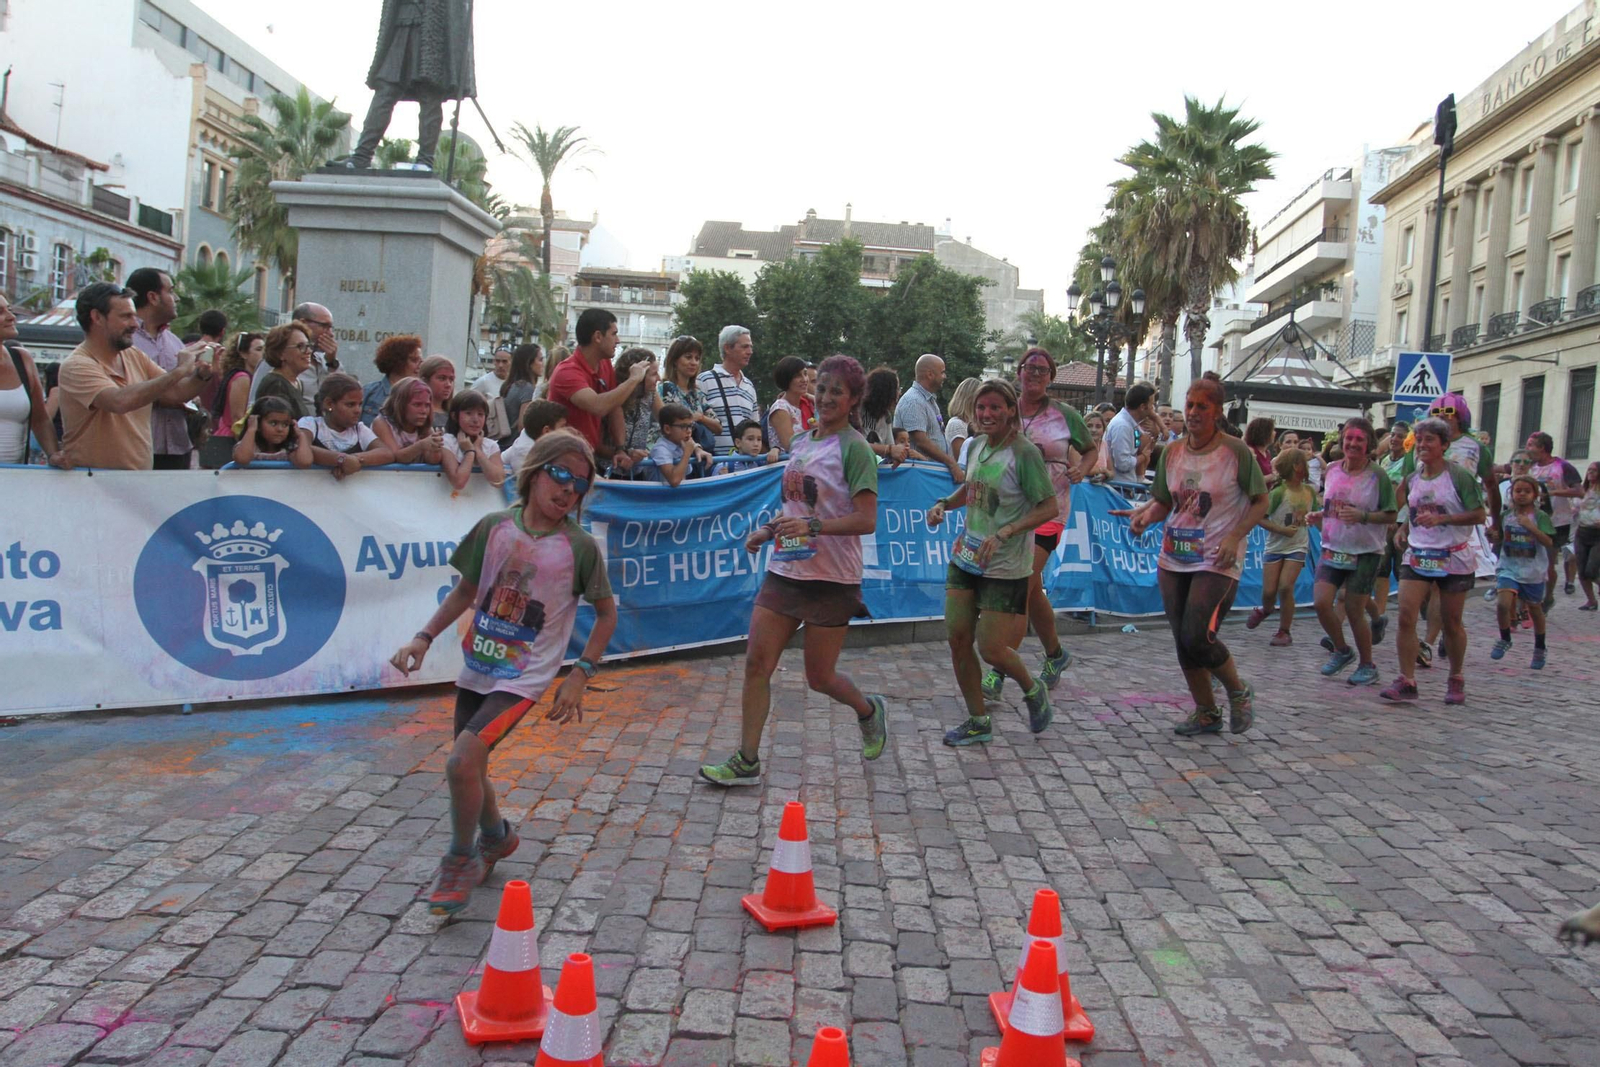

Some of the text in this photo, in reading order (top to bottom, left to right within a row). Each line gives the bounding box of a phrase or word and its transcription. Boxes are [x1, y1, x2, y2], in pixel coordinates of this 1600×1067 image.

[1482, 54, 1547, 118] BANCO
[1556, 41, 1573, 65] DE
[340, 280, 386, 293] HUELVA
[358, 304, 366, 317] A
[1301, 417, 1337, 430] FERNANDO
[889, 541, 920, 566] DE
[1173, 540, 1191, 552] 718
[222, 565, 232, 573] ET
[623, 555, 659, 588] DE
[209, 578, 219, 628] PORTUS MARIS
[267, 583, 276, 617] CUSTODIA
[473, 634, 508, 660] 503
